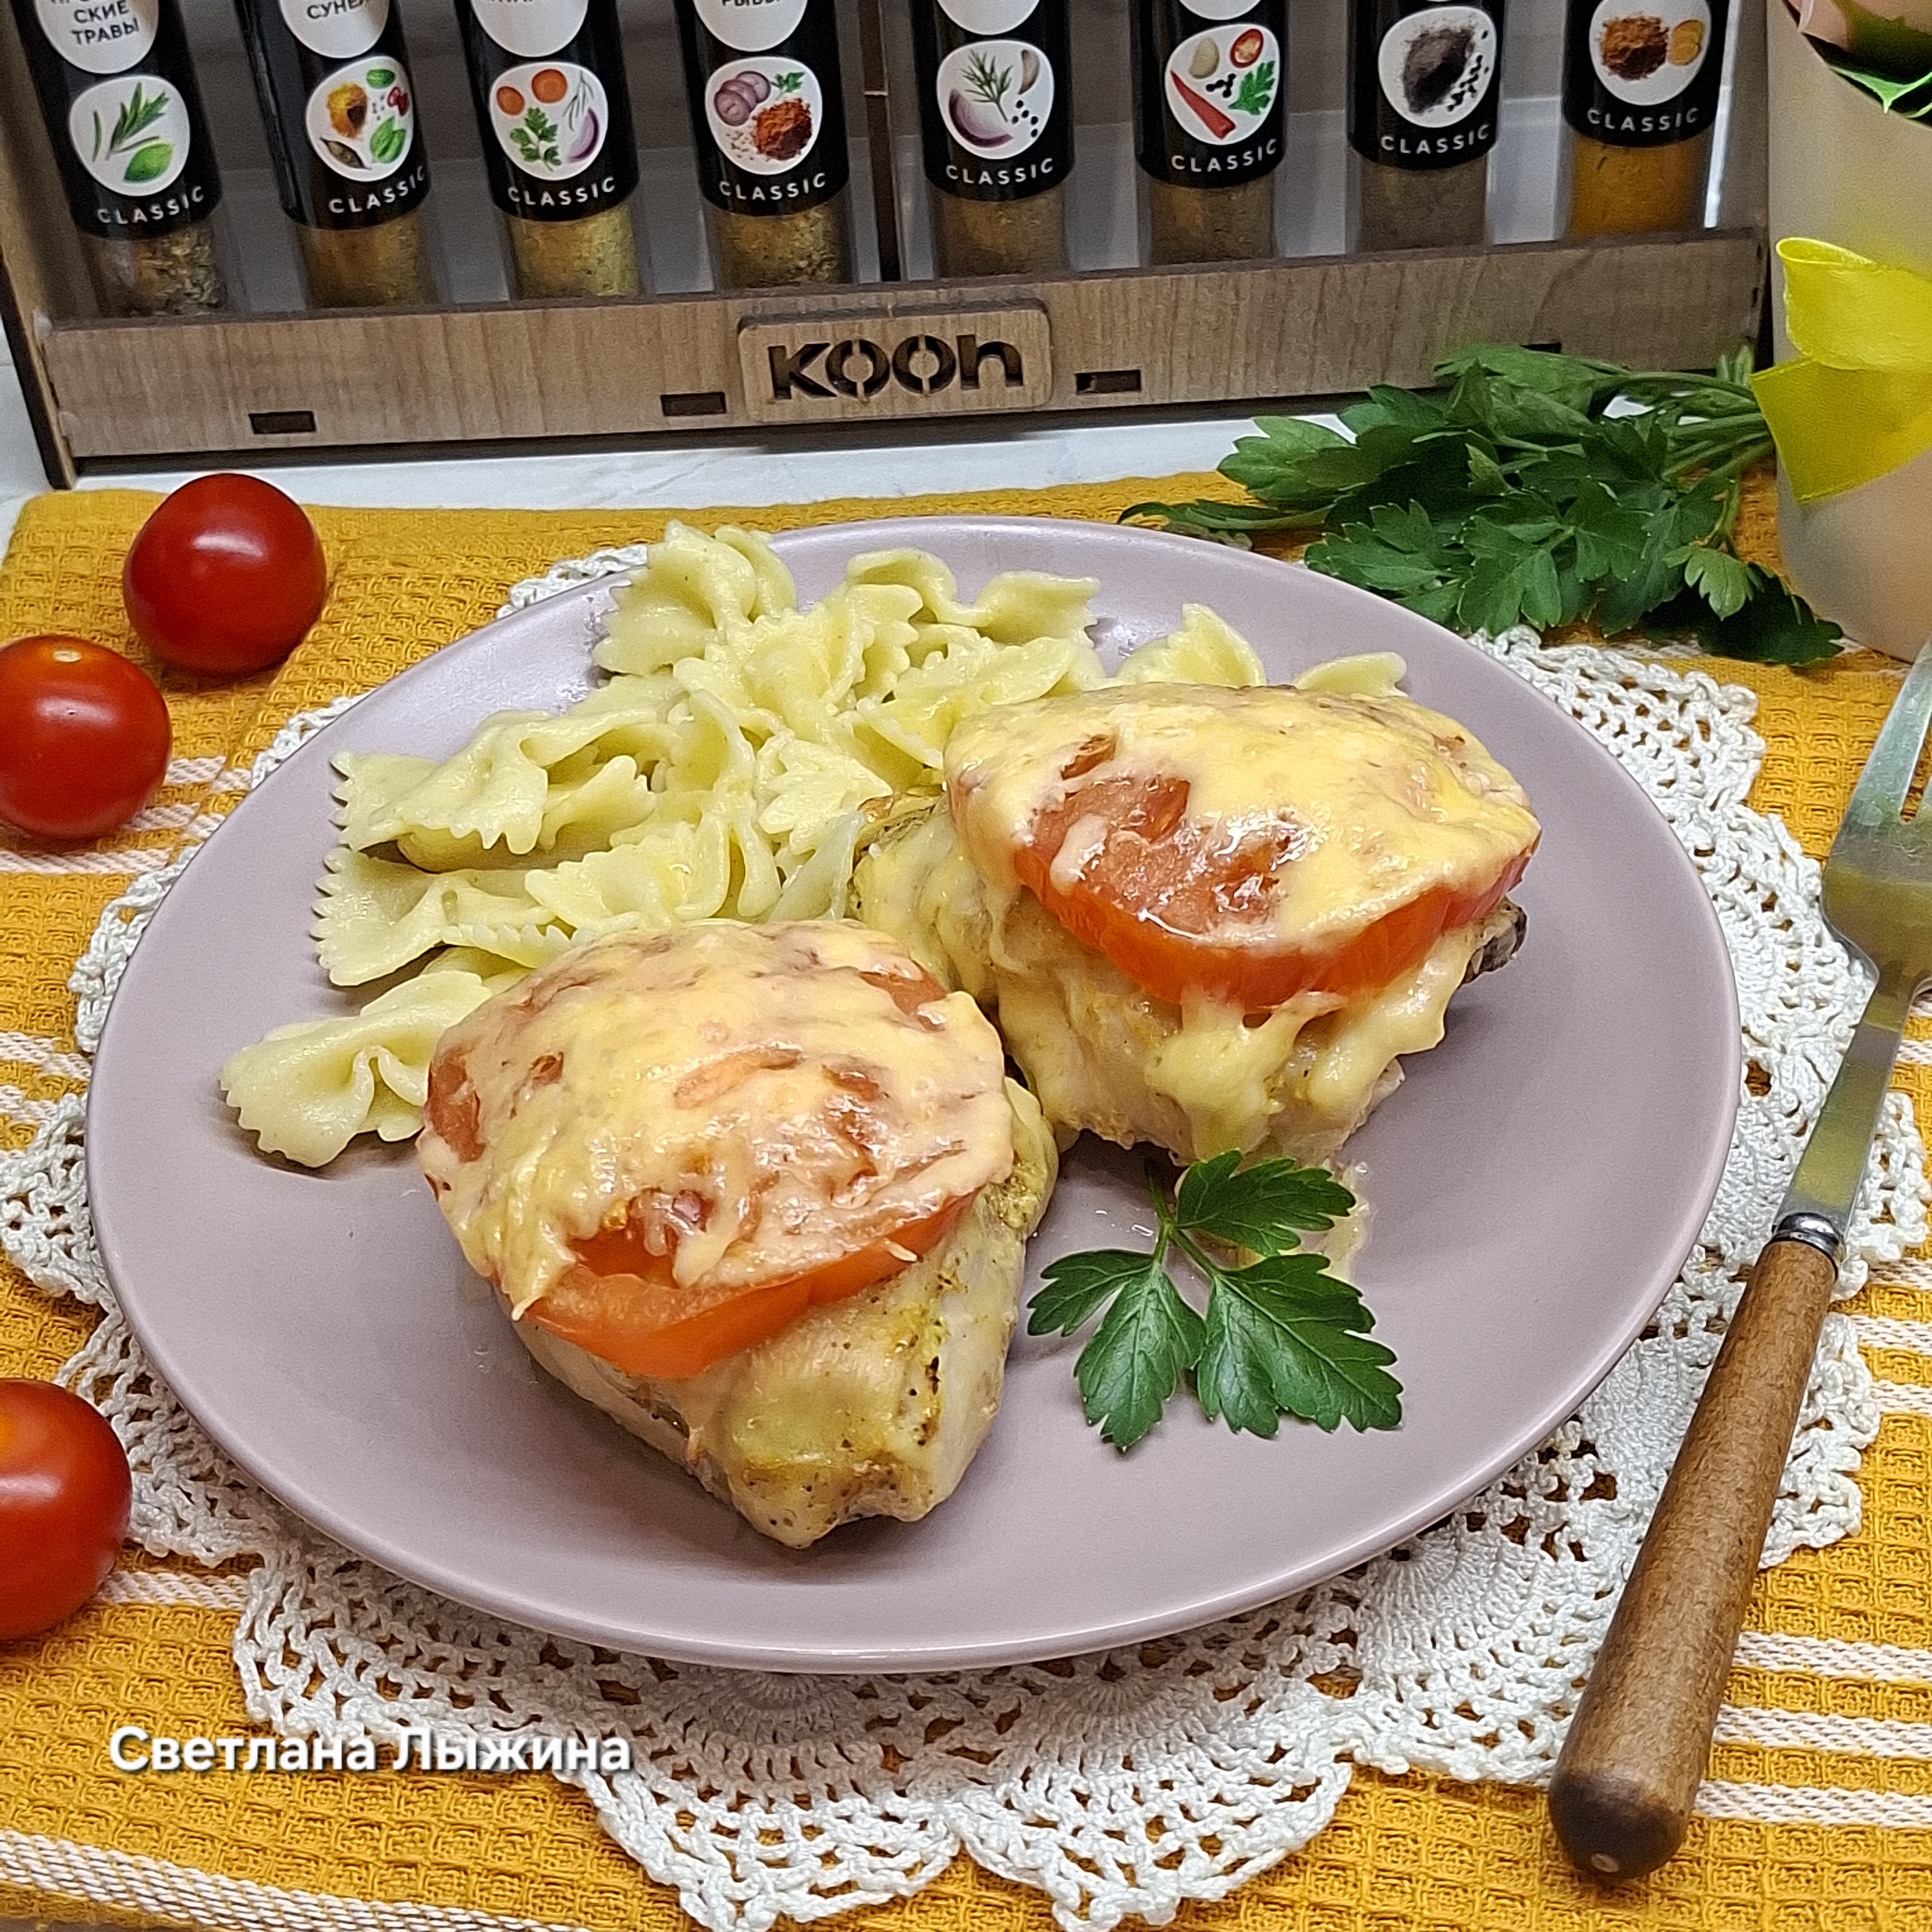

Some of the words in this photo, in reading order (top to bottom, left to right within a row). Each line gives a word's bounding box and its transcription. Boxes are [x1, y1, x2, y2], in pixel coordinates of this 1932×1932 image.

[74, 0, 130, 23] СКИЕ
[307, 0, 370, 19] СУНЕ
[72, 17, 139, 45] ТРАВЫ
[1587, 107, 1698, 132] CLASSIC
[1381, 123, 1489, 154] CLASSIC
[1171, 138, 1277, 172] CLASSIC
[945, 158, 1053, 185] CLASSIC
[328, 159, 424, 214] CLASSIC
[508, 176, 615, 207] CLASSIC
[719, 172, 826, 201] CLASSIC
[98, 186, 204, 224] CLASSIC
